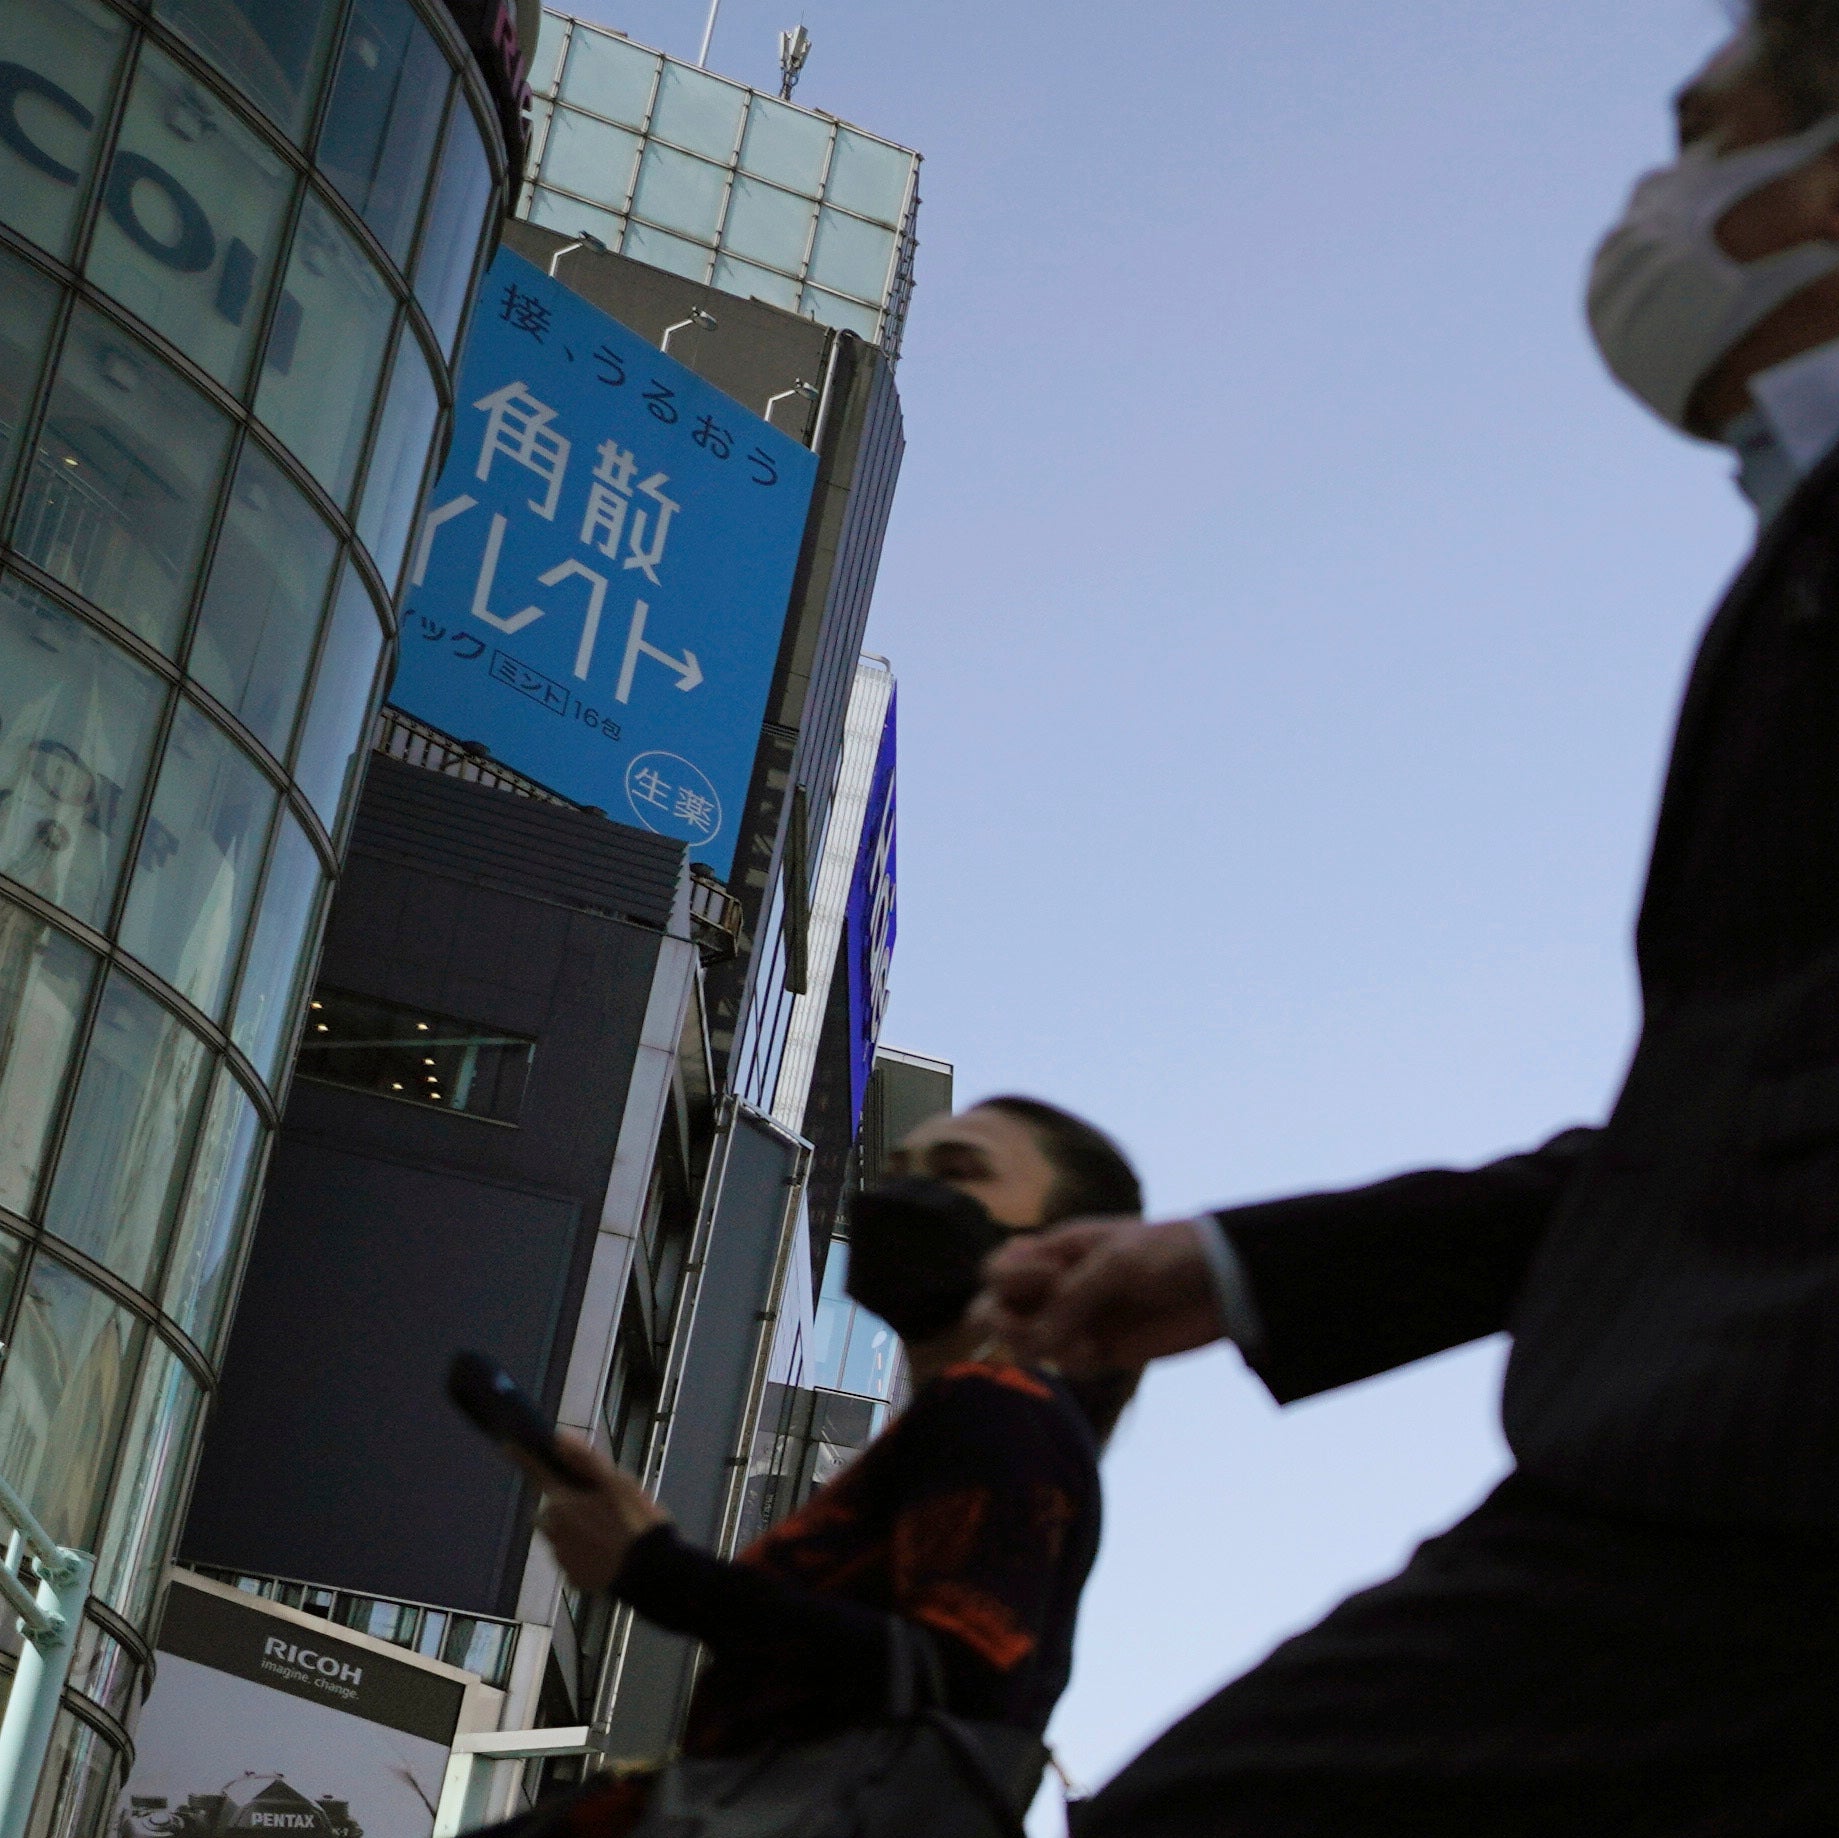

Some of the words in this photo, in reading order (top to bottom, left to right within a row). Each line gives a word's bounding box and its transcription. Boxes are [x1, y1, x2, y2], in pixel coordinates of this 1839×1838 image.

[500, 282, 778, 486] 接、うるおう
[473, 381, 680, 587] 角散
[411, 494, 703, 704] イレクト
[402, 609, 486, 659] ィック
[499, 655, 559, 705] ミント
[571, 700, 621, 741] 16包
[631, 766, 713, 833] 生薬
[261, 1659, 312, 1684] imagine.
[313, 1677, 360, 1700] change.
[264, 1636, 362, 1686] RICOH
[251, 1812, 316, 1828] PENTAX
